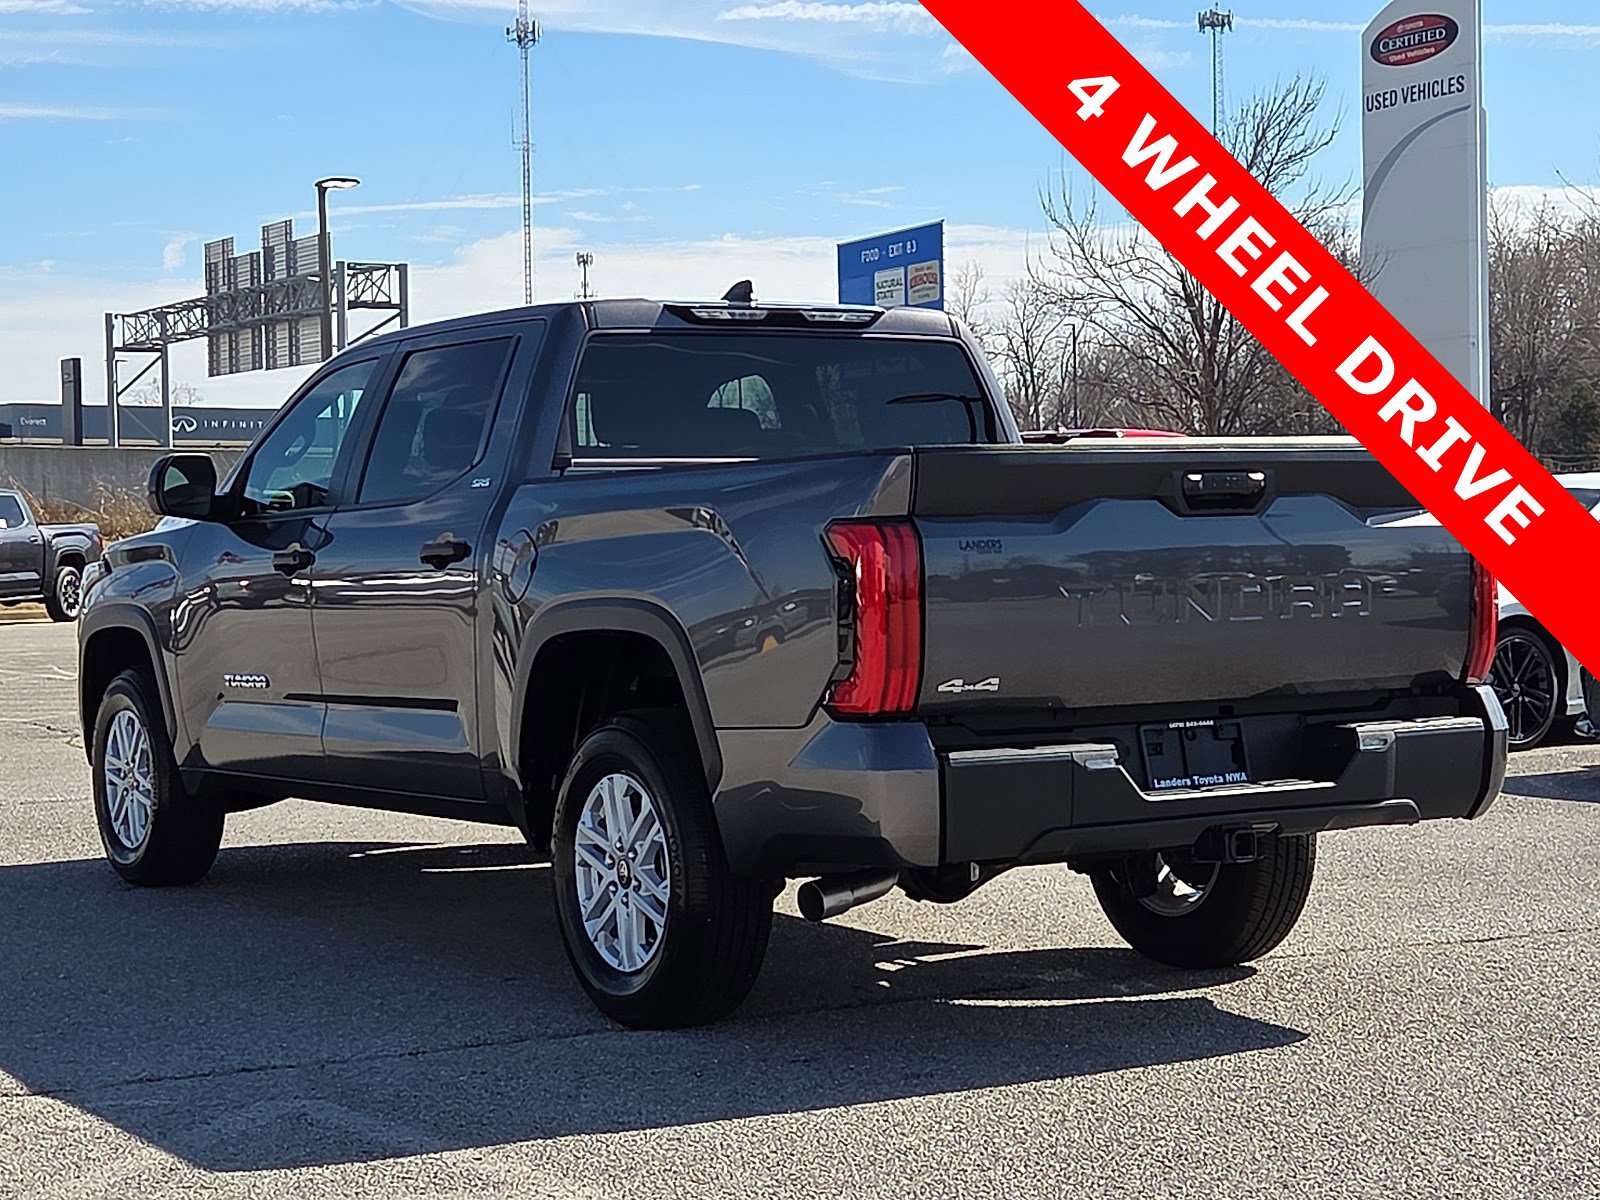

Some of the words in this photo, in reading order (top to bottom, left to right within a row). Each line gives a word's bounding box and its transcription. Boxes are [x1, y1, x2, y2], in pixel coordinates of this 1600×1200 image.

[1380, 28, 1446, 53] CERTIFIED
[1366, 90, 1398, 112] USED
[1401, 75, 1465, 104] VEHICLES
[861, 248, 879, 262] FOOD
[888, 243, 903, 257] EXIT
[876, 278, 903, 290] NATURAL
[876, 290, 895, 301] STATE
[203, 419, 264, 429] INFINIT
[471, 478, 491, 488] SR5
[959, 539, 1003, 552] LANDERS
[1058, 573, 1372, 627] TUNDRA
[938, 677, 1000, 693] 4x4
[1154, 777, 1191, 788] Landers
[1193, 774, 1224, 786] Toyota
[1225, 772, 1248, 782] NWA
